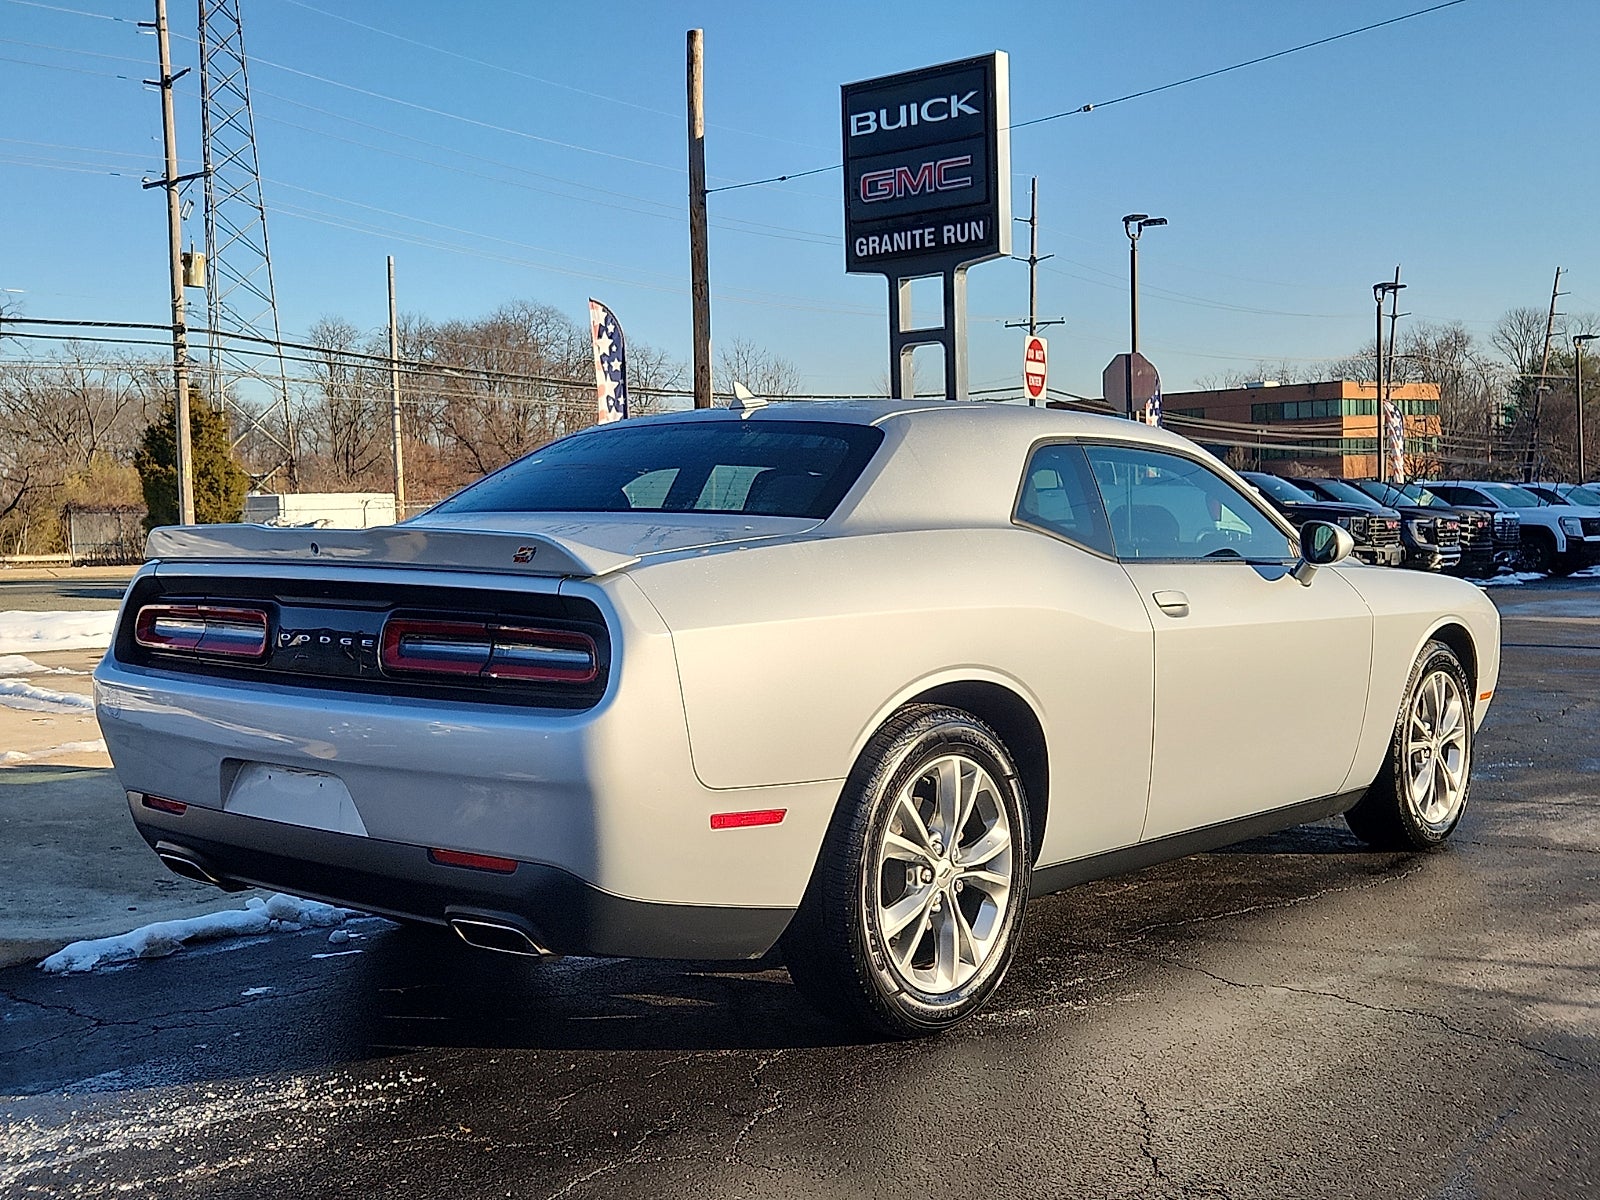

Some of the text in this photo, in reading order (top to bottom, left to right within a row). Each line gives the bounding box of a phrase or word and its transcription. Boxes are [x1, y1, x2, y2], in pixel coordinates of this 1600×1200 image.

[850, 91, 980, 136] BUICK
[861, 155, 971, 203] GMC
[855, 220, 984, 257] GRANITE RUN
[281, 634, 373, 647] DODGE
